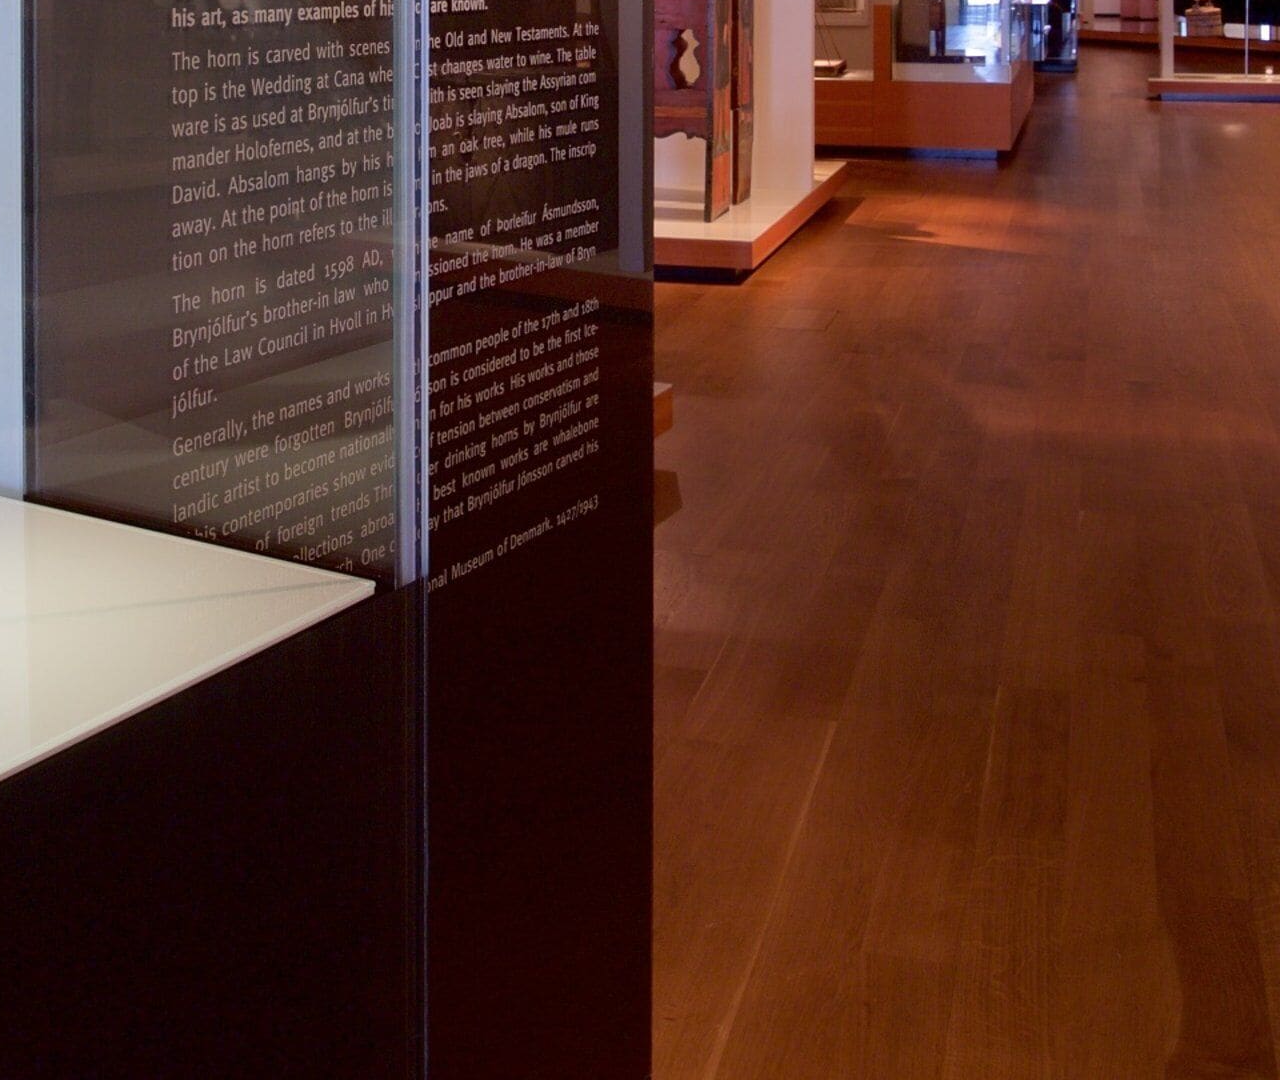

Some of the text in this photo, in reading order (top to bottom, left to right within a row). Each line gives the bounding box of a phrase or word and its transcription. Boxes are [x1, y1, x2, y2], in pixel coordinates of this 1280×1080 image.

[172, 0, 377, 29] his art, as many examples of
[171, 40, 390, 71] The horn is carved with scenes
[171, 69, 365, 108] top is the Wedding at Cana
[171, 217, 216, 238] away.
[220, 209, 237, 229] At
[241, 204, 265, 225] the
[269, 197, 305, 224] point
[309, 190, 324, 212] of
[326, 189, 348, 209] the
[351, 185, 379, 203] horn
[383, 179, 393, 197] is
[333, 287, 356, 305] law
[363, 276, 389, 297] who
[172, 371, 390, 457] Generally, the names and works
